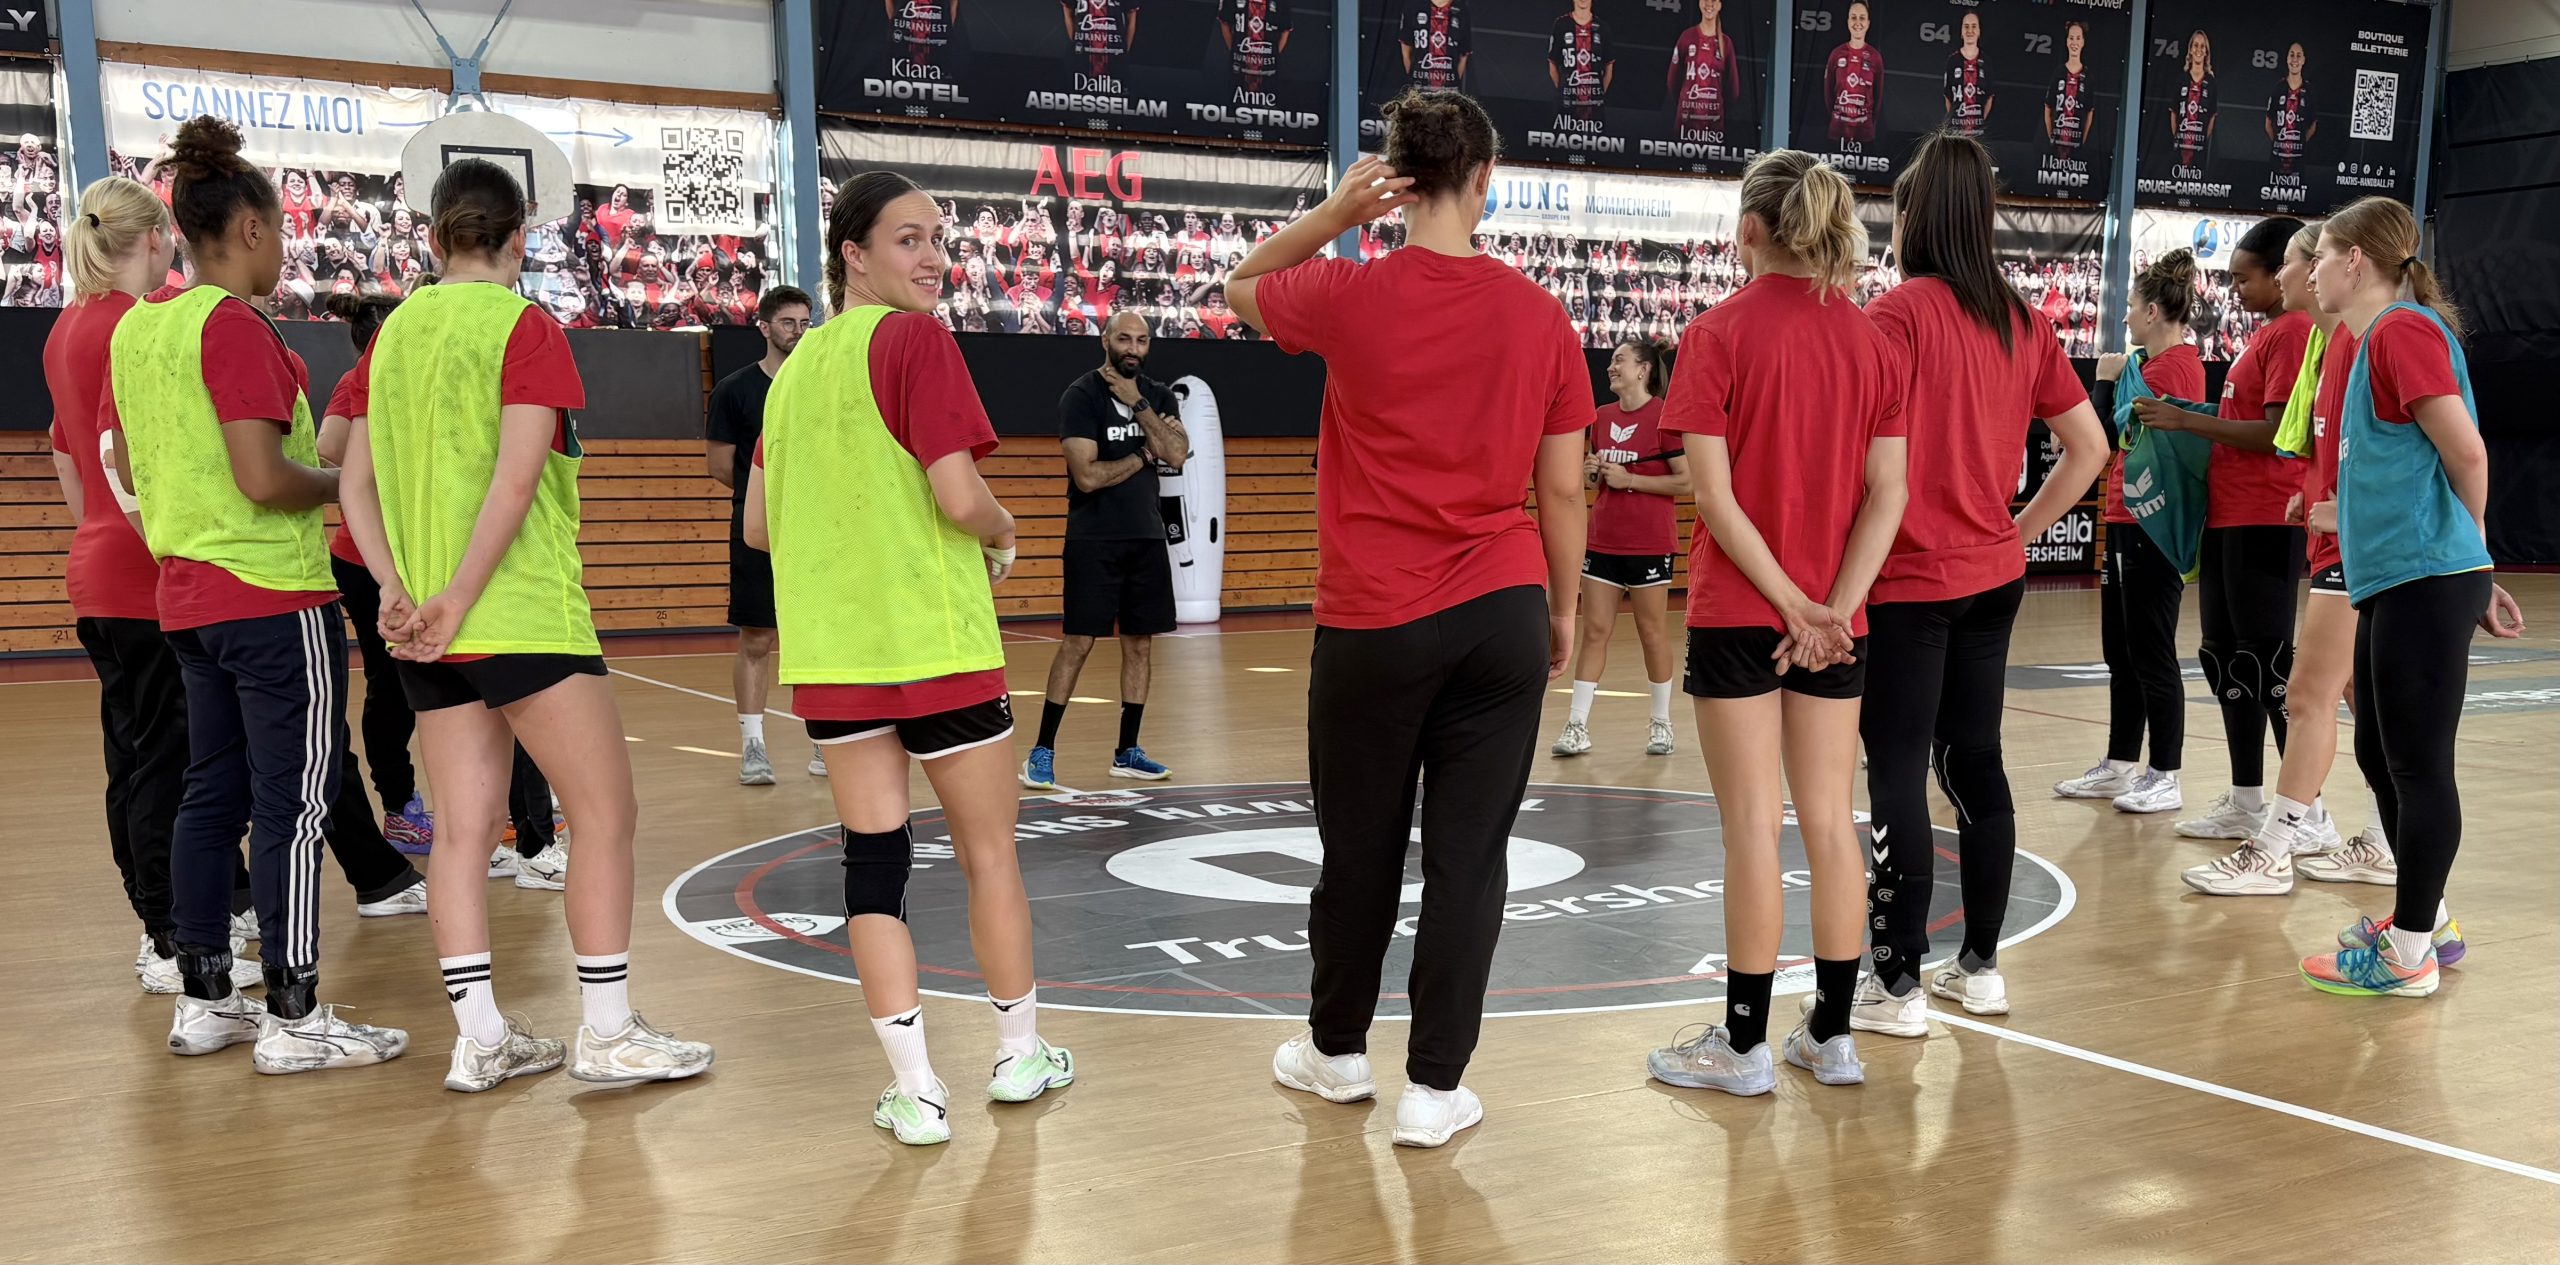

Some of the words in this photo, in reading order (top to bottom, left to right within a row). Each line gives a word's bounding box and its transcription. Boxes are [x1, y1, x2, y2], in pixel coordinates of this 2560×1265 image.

[894, 19, 947, 32] EURINVEST
[1800, 10, 1832, 31] 53
[1919, 22, 1950, 43] 64
[2358, 30, 2404, 44] BOUTIQUE
[2024, 32, 2052, 54] 72
[2154, 38, 2179, 59] 74
[2351, 42, 2408, 57] BILLETTERIE
[892, 58, 941, 79] Kiara
[2252, 49, 2278, 69] 83
[864, 78, 969, 103] DIOTEL
[1074, 73, 1121, 93] Dalila
[1025, 91, 1168, 118] ABDESSELAM
[1233, 86, 1276, 106] Anne
[143, 82, 295, 129] SCANNEZ
[303, 95, 364, 135] MOI
[1186, 103, 1319, 129] TOLSTRUP
[1553, 114, 1603, 133] Albane
[1527, 131, 1625, 153] FRACHON
[1680, 125, 1724, 143] Louise
[1640, 139, 1756, 163] DENOYELLE
[1841, 137, 1862, 153] Léa
[1030, 145, 1143, 202] AEG
[2042, 154, 2088, 173] Margaux
[2172, 164, 2202, 180] Olivia
[2038, 170, 2089, 187] IMHOF
[2137, 179, 2231, 198] ROUGE-CARRASSAT
[2270, 171, 2300, 189] Lyson
[1504, 180, 1569, 211] JUNG
[1585, 195, 1671, 218] MOMMENHEIM
[656, 610, 668, 620] 25
